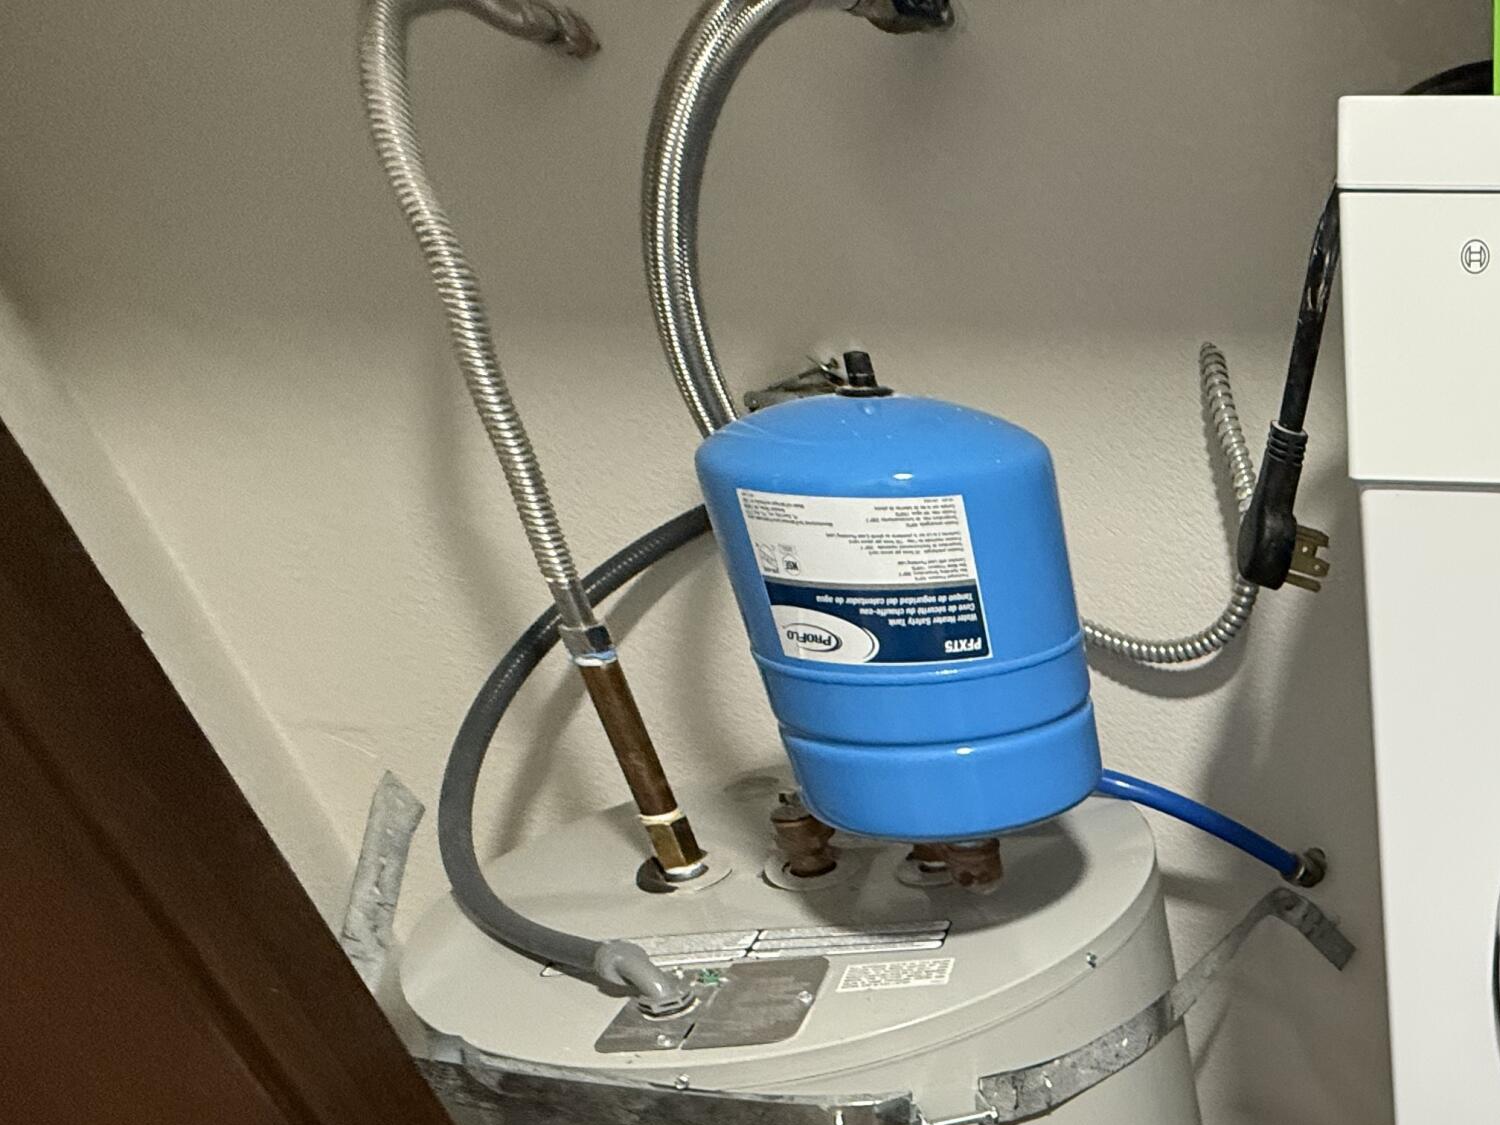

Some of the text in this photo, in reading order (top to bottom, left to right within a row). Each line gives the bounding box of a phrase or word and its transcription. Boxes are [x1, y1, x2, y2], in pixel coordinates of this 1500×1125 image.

[938, 594, 946, 602] de
[947, 604, 957, 612] de
[888, 613, 978, 627] Water Heater Safety Tank
[944, 637, 982, 653] PFXT5
